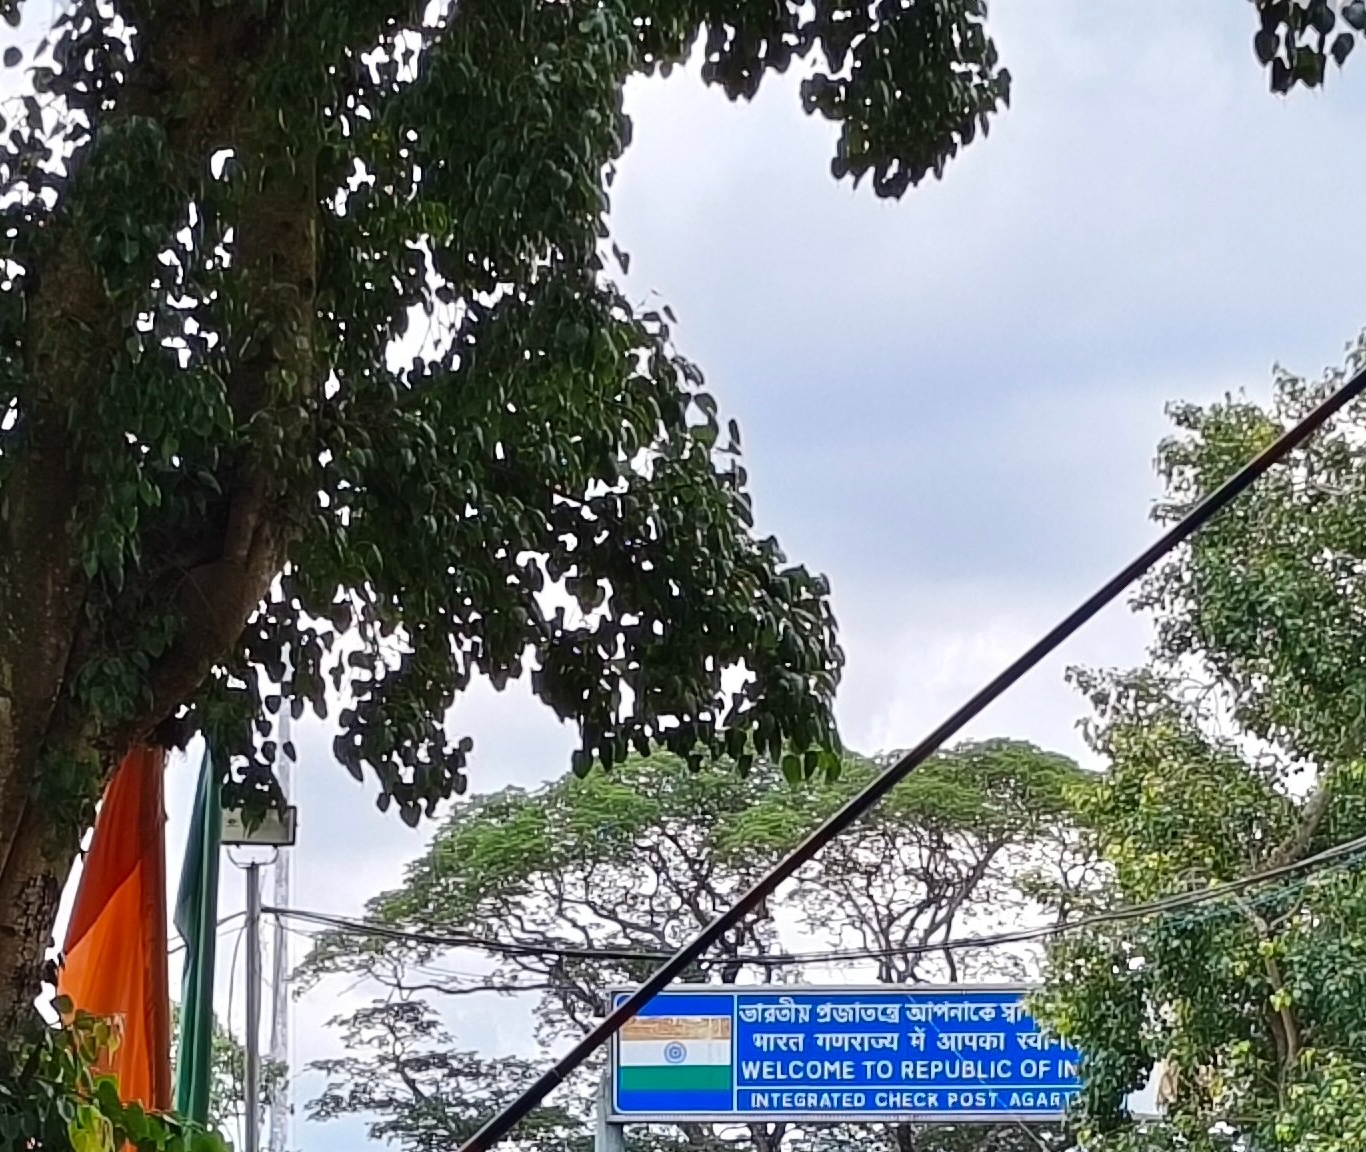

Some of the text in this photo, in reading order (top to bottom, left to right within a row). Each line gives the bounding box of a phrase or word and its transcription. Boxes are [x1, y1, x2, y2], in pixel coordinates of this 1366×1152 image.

[738, 997, 812, 1023] ভারতীয়
[905, 1001, 998, 1023] আপনাকে
[752, 1033, 805, 1052] भारत
[813, 1032, 899, 1052] गणराज्य
[907, 1025, 926, 1051] में
[936, 1032, 1005, 1051] आपका
[741, 1060, 856, 1081] WELCOME
[861, 1060, 894, 1081] TO
[901, 1060, 1012, 1079] REPUBLIC
[1020, 1060, 1051, 1079] OF
[750, 1092, 866, 1108] INTEGRATED
[874, 1092, 938, 1108] CHECK
[947, 1092, 998, 1108] POST
